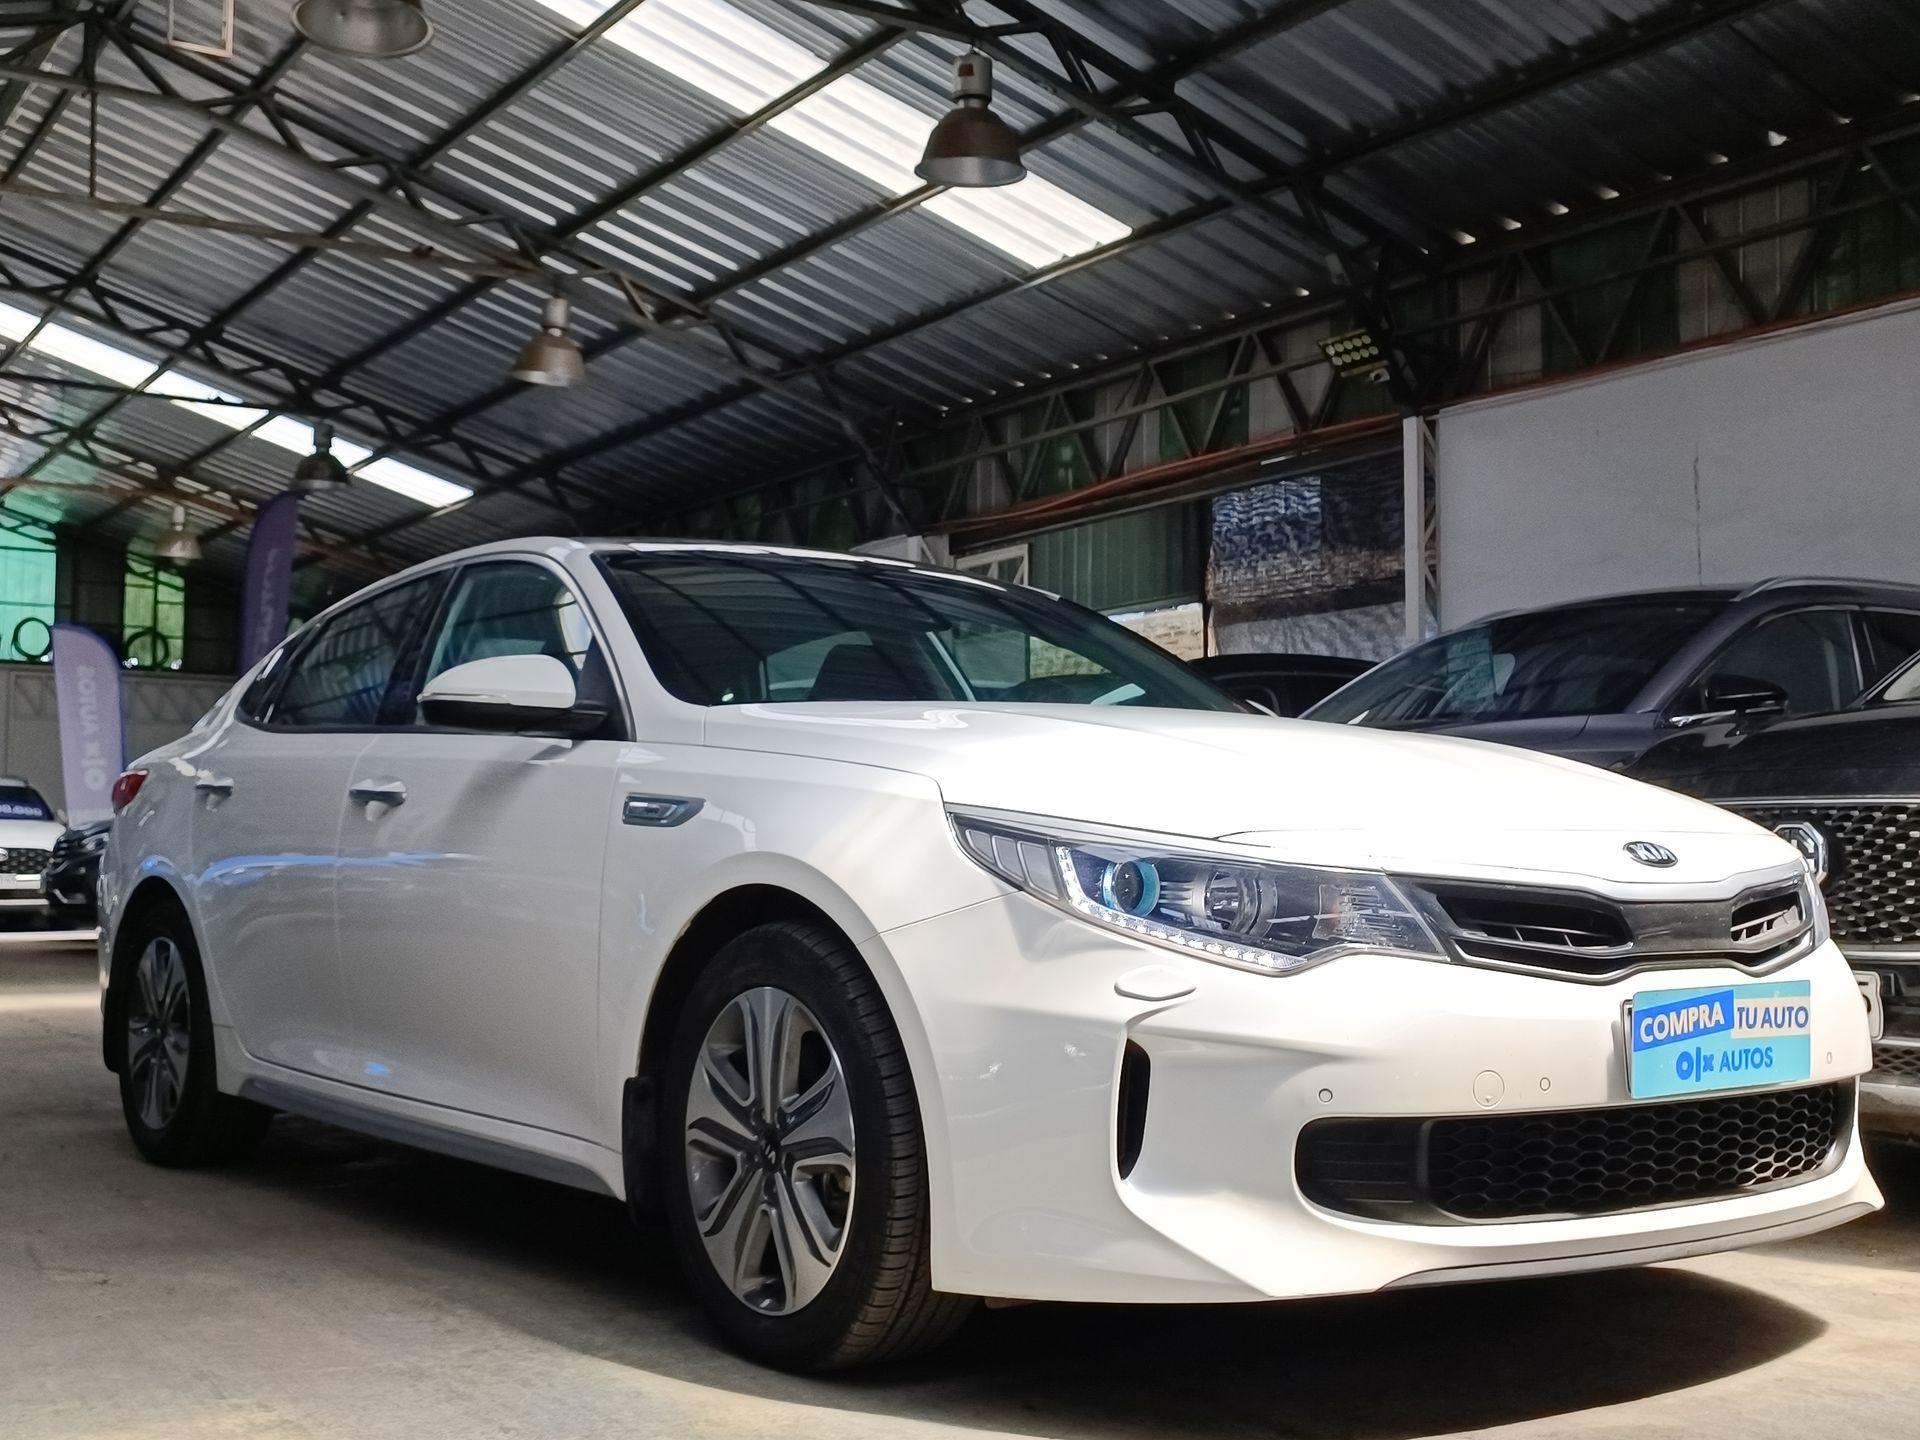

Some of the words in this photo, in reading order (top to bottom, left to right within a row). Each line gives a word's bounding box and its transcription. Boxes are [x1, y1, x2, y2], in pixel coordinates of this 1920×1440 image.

[1626, 842, 1677, 864] KIA
[1639, 1000, 1725, 1043] COMPRA
[1736, 1005, 1758, 1030] TU
[1760, 1004, 1810, 1030] AUTO
[1718, 1046, 1774, 1074] AUTOS
